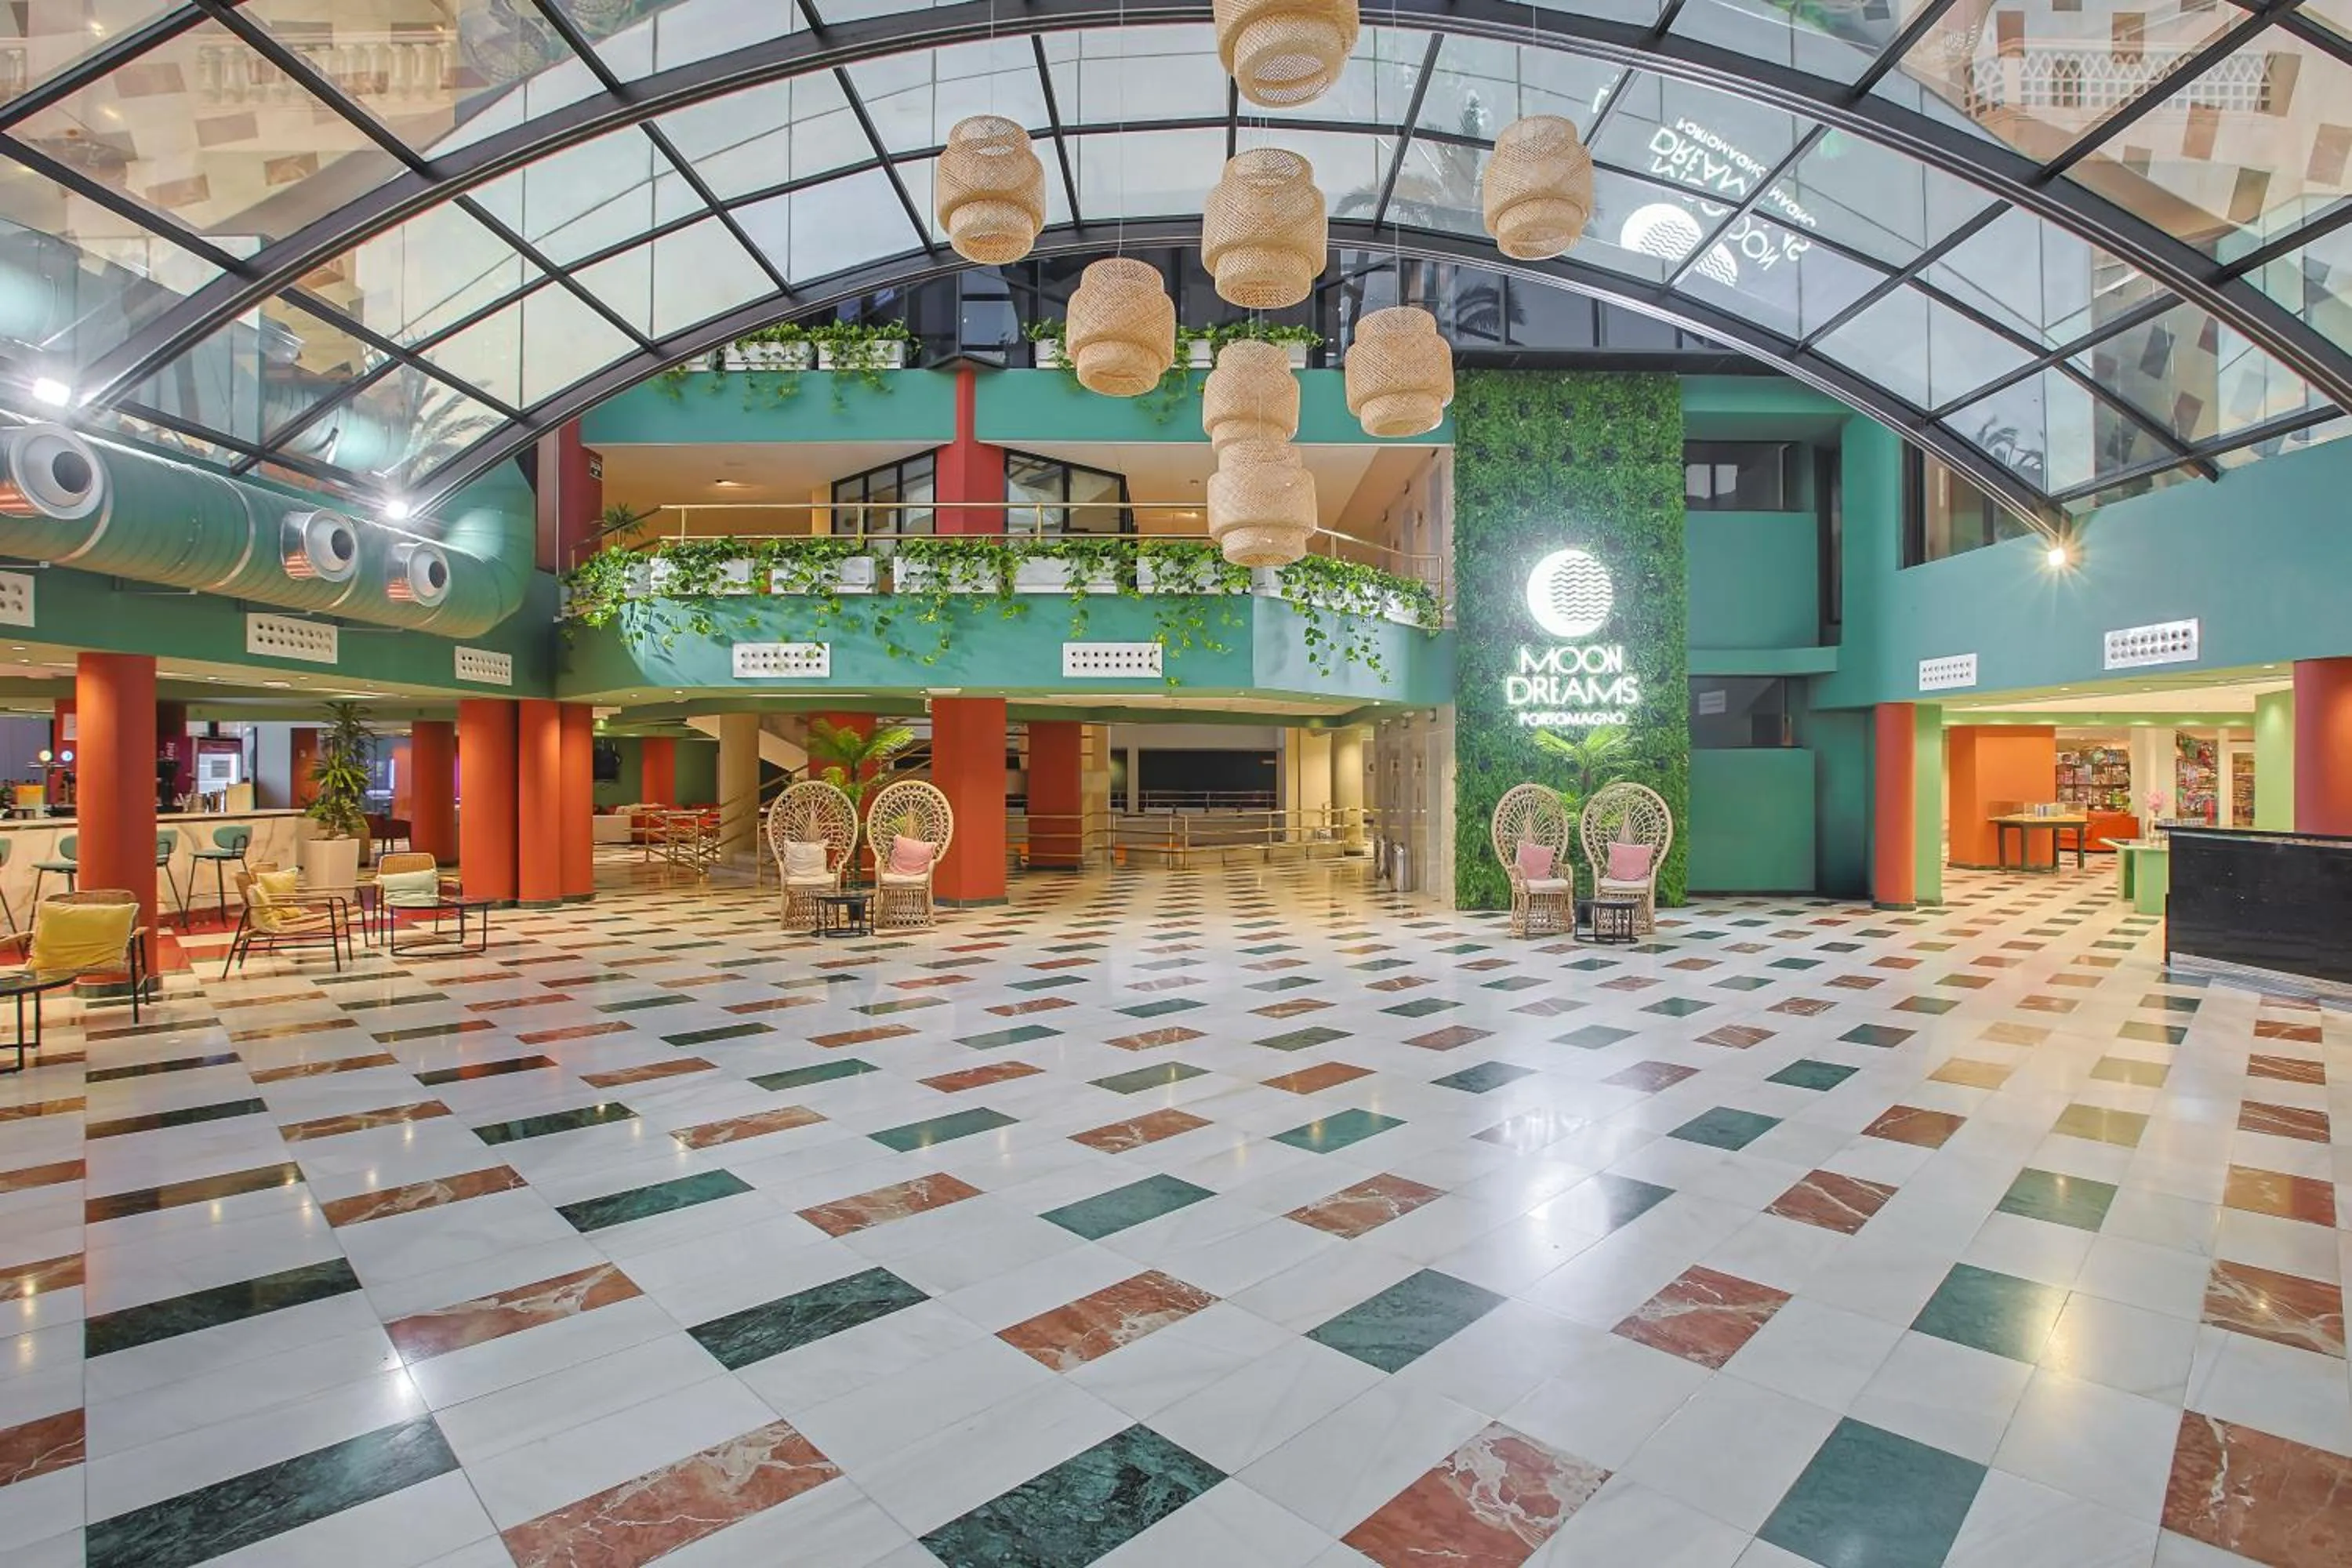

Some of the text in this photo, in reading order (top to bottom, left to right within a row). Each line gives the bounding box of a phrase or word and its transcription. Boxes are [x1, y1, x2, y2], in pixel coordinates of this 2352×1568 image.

[1519, 645, 1624, 673] MOON
[1506, 676, 1639, 706] DREAMS
[1519, 711, 1628, 726] PORTOMAGNO
